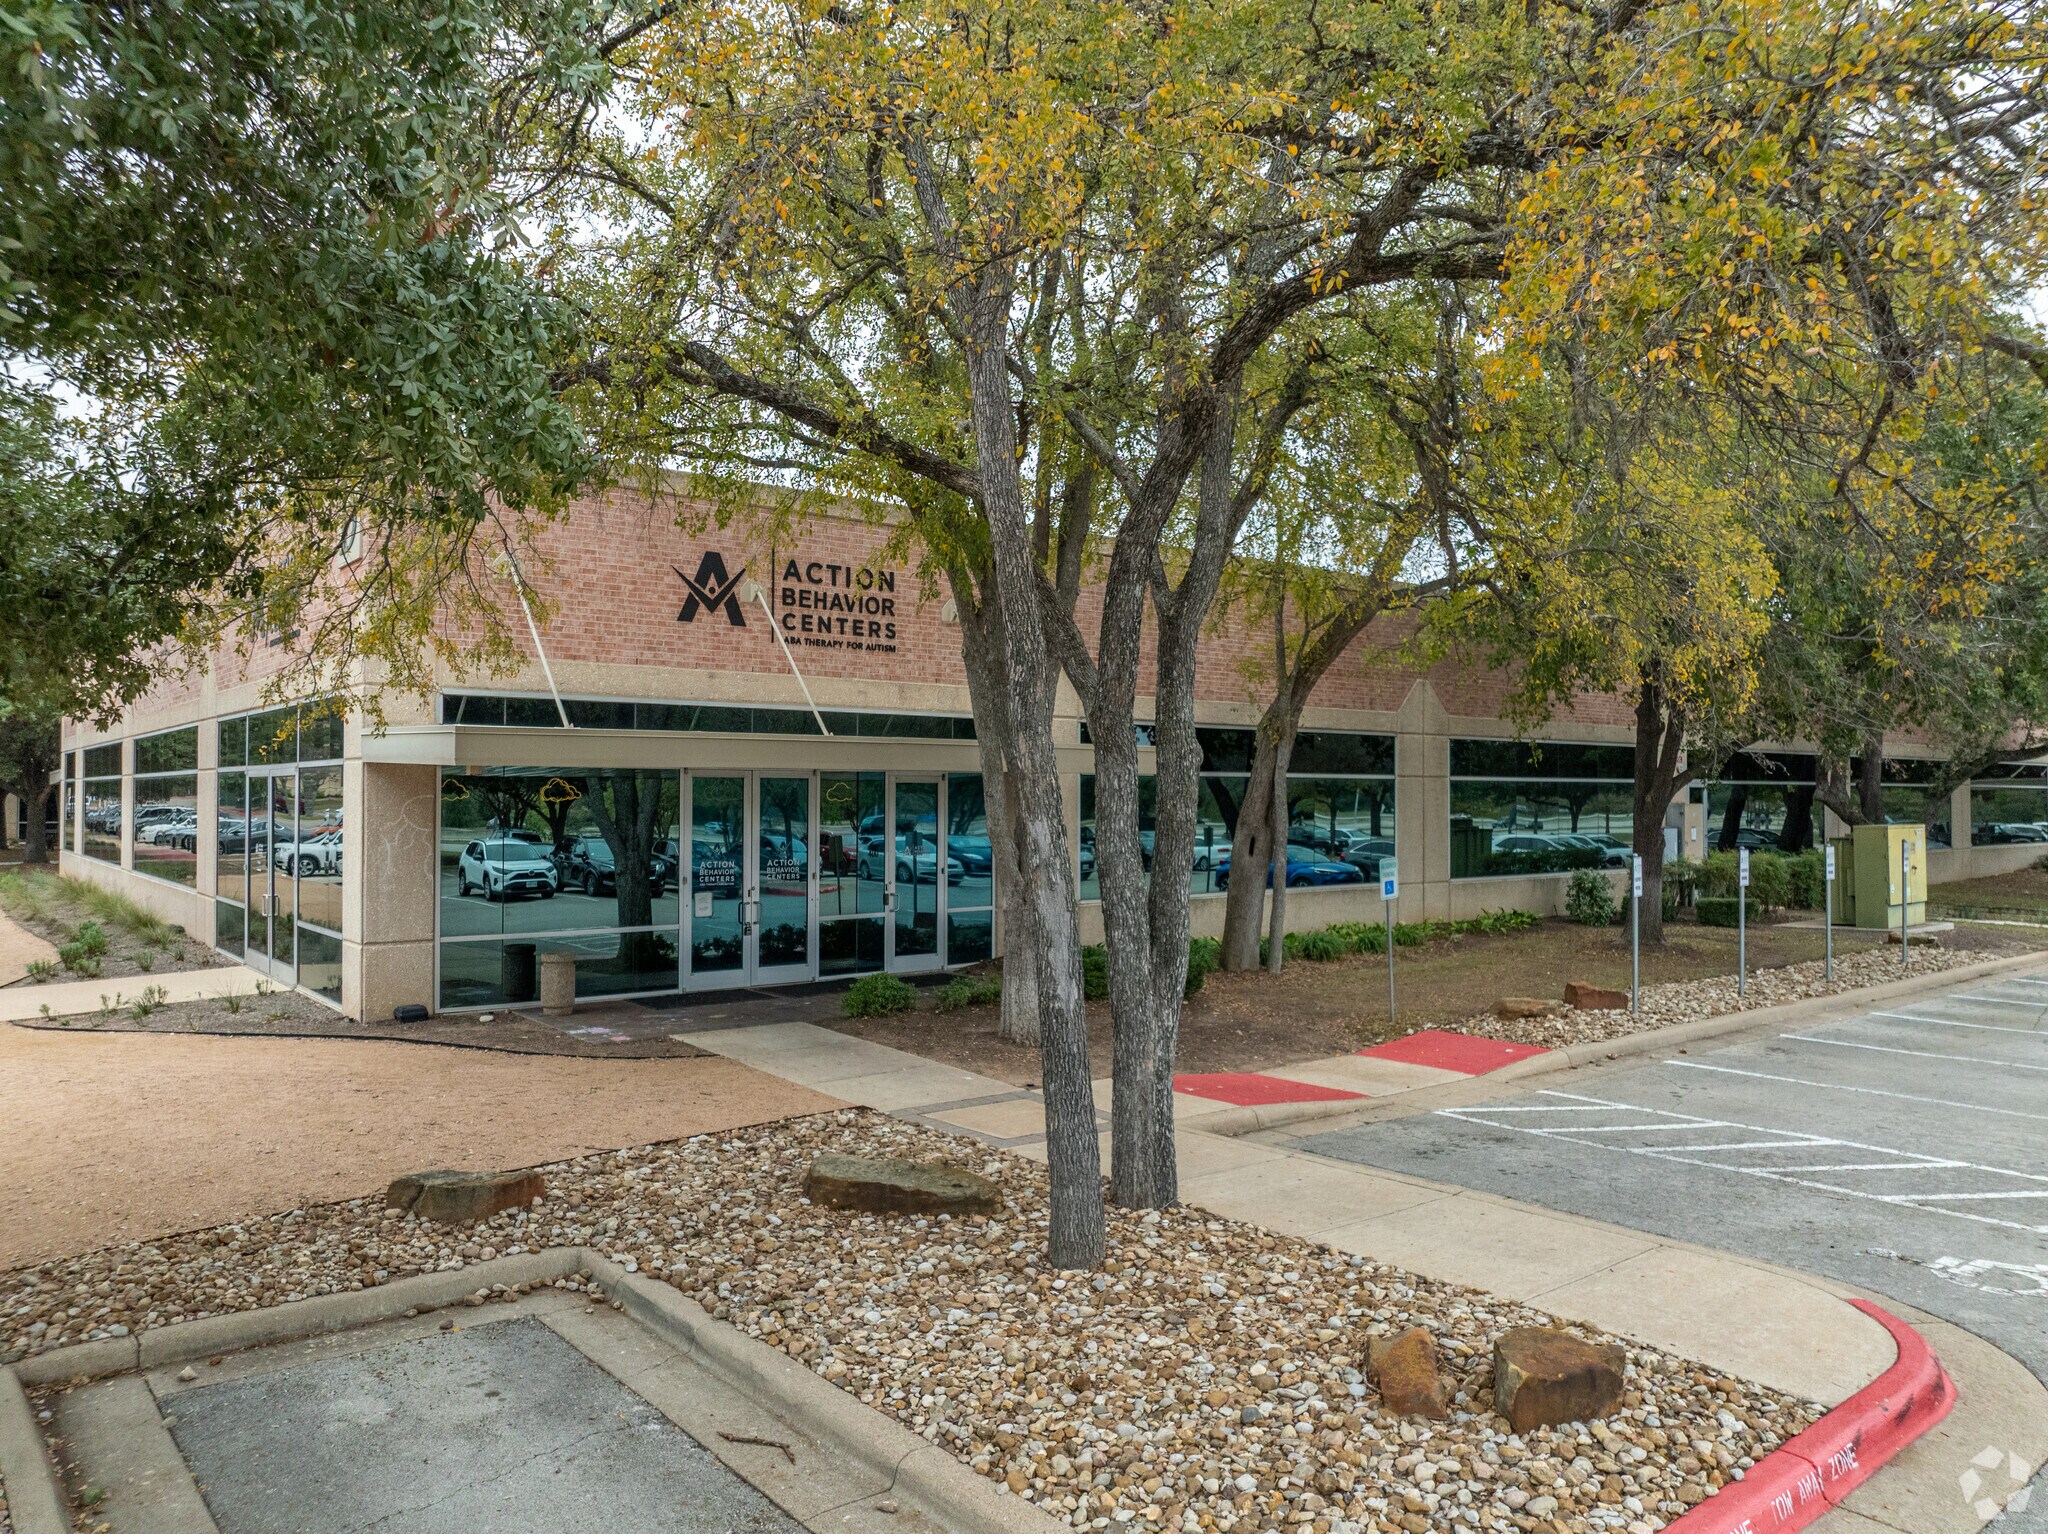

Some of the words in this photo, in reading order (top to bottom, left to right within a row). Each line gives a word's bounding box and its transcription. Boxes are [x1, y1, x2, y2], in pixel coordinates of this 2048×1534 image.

[783, 559, 895, 592] ACTION
[782, 587, 895, 616] BEHAVIOR
[782, 613, 896, 639] CENTERS
[784, 636, 802, 645] ABA
[804, 637, 844, 649] THERAPY
[846, 641, 864, 651] FOR
[865, 643, 896, 653] AUTISM
[1770, 1489, 1795, 1526] TOW
[1797, 1466, 1825, 1506] AWAY
[1828, 1442, 1859, 1481] ZONE
